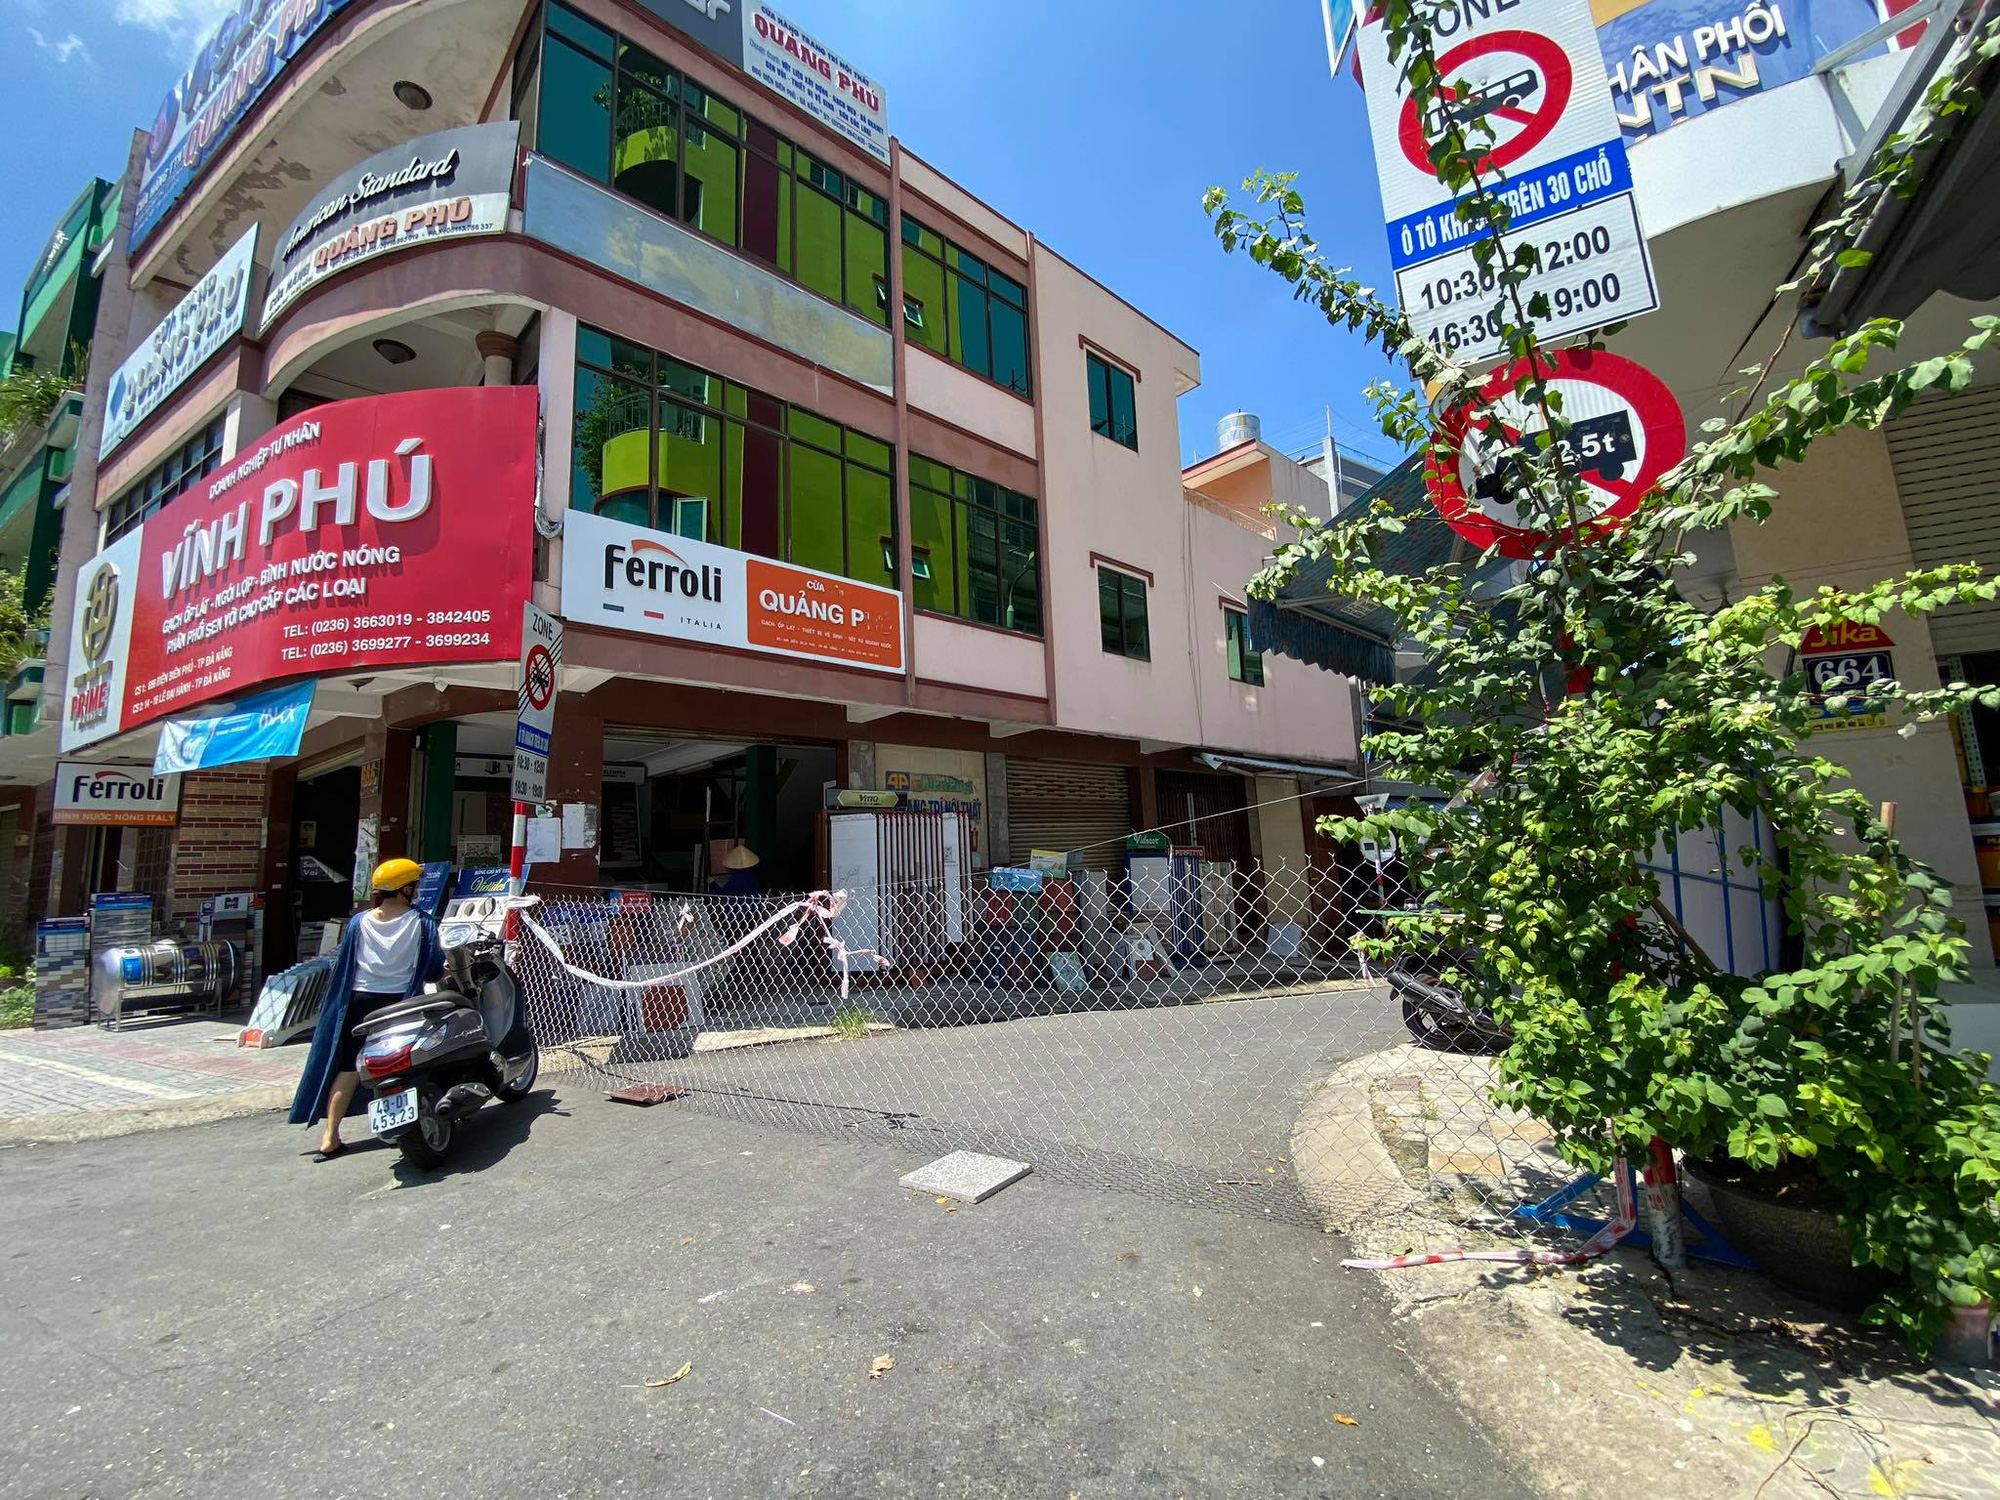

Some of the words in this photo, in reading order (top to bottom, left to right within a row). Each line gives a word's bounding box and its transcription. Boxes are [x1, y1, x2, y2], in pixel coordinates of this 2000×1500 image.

[1608, 44, 1688, 94] HÂN
[349, 149, 459, 203] Standard
[1415, 215, 1437, 251] TÔ
[1547, 172, 1571, 204] 30
[1573, 147, 1613, 195] CHỖ
[209, 473, 236, 499] DOANH
[284, 421, 321, 449] NHÂN
[162, 500, 251, 600] VĨNH
[259, 438, 433, 547] PHÚ
[260, 561, 288, 587] BÌNH
[291, 550, 338, 576] NƯỚC
[343, 543, 401, 567] NÓNG
[604, 543, 722, 603] Ferroli
[806, 579, 825, 592] CỬA
[205, 616, 223, 637] SEN
[239, 600, 259, 621] CAO
[259, 586, 283, 612] CẤP
[285, 581, 320, 605] CÁC
[323, 577, 367, 599] LOẠI
[680, 616, 722, 630] ITALIA
[759, 590, 844, 625] QUẢNG
[283, 624, 308, 639] TEL:
[311, 617, 349, 636] (0236)
[353, 613, 413, 629] 3663019
[427, 610, 491, 625] 3842405
[532, 613, 553, 641] ZONE
[282, 646, 307, 661] TEL:
[310, 640, 348, 658] (0236)
[352, 635, 411, 651] 3699277
[426, 633, 490, 648] 3699234
[1814, 655, 1886, 687] 664
[72, 775, 164, 803] Ferroli
[114, 812, 144, 821] NÓNG
[372, 1106, 415, 1131] 453.23
[376, 1093, 408, 1114] 43-D1
